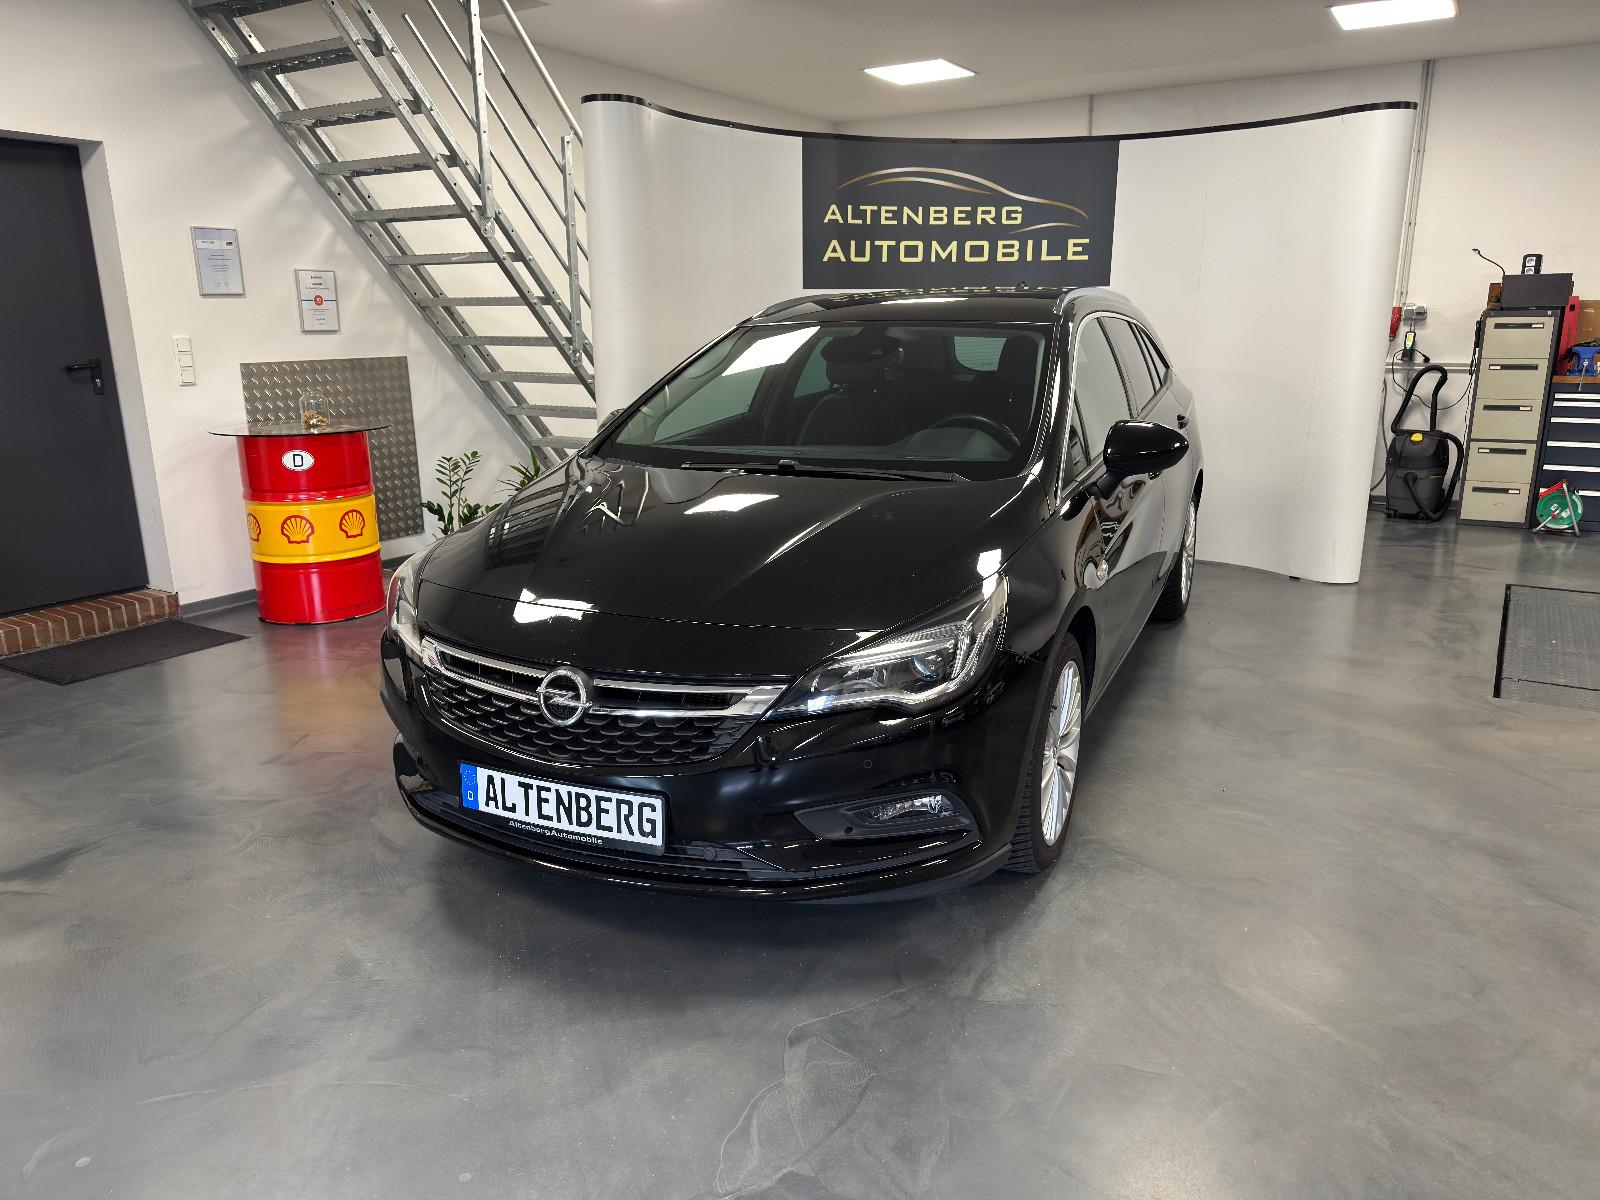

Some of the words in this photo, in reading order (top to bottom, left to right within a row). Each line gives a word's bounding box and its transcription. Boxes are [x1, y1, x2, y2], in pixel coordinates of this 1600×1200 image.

[823, 204, 1023, 225] ALTENBERG
[822, 238, 1090, 263] AUTOMOBILE
[292, 453, 304, 468] D
[467, 790, 474, 801] D
[484, 774, 657, 839] ALTENBERG
